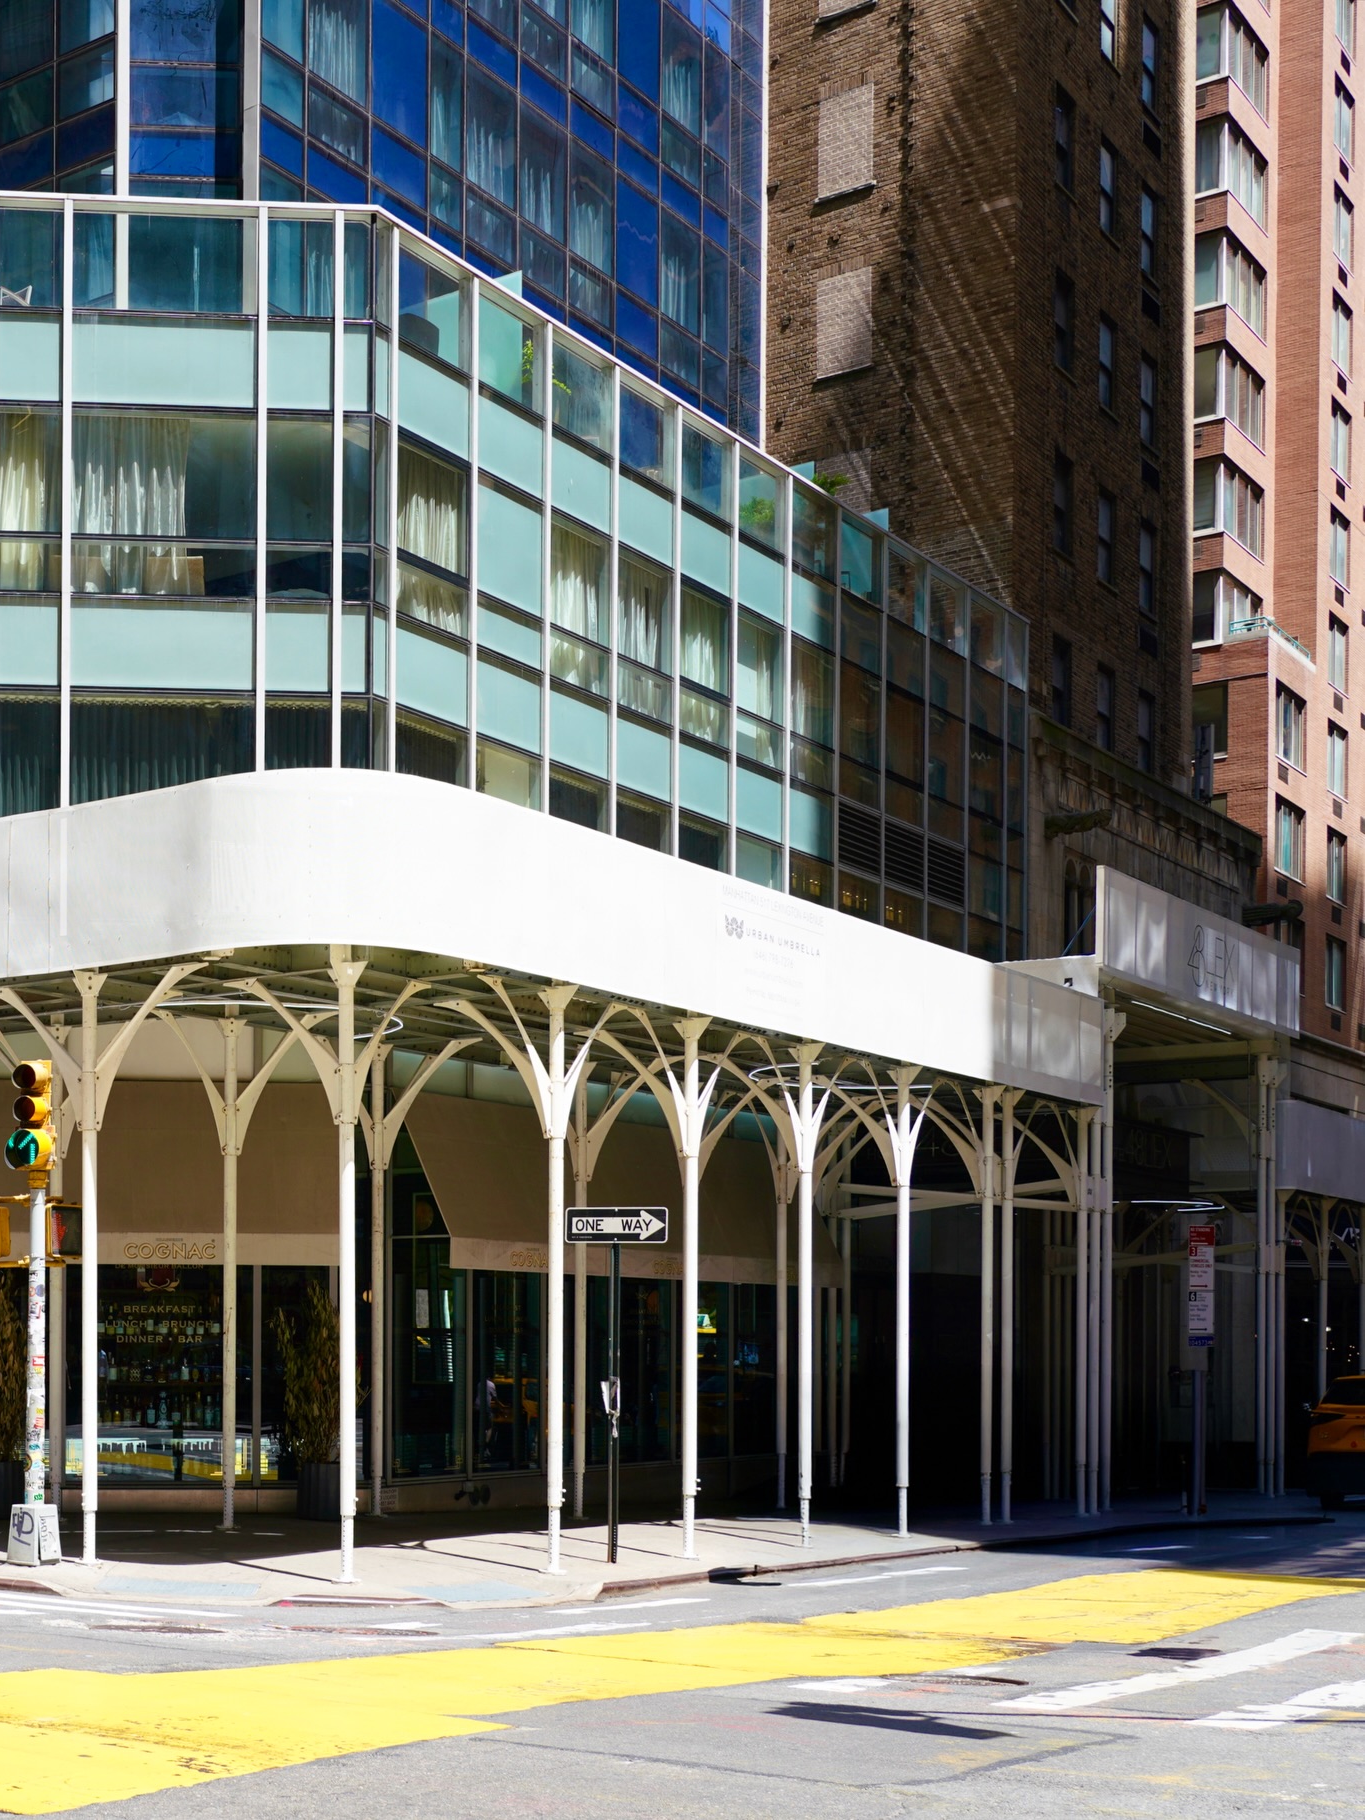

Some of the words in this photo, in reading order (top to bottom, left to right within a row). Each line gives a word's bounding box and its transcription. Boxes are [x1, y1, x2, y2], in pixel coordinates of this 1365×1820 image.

[746, 927, 775, 943] URBAN
[778, 937, 820, 957] UMBRELLA
[575, 1218, 604, 1232] ONE
[621, 1218, 653, 1232] WAY
[124, 1242, 216, 1260] COGNAC
[510, 1251, 549, 1268] COGNA
[123, 1305, 196, 1314] BREAKFAST
[105, 1320, 147, 1328] LUNCH
[162, 1320, 214, 1328] BRUNCH
[116, 1335, 163, 1343] DINNER
[178, 1335, 203, 1343] BAR
